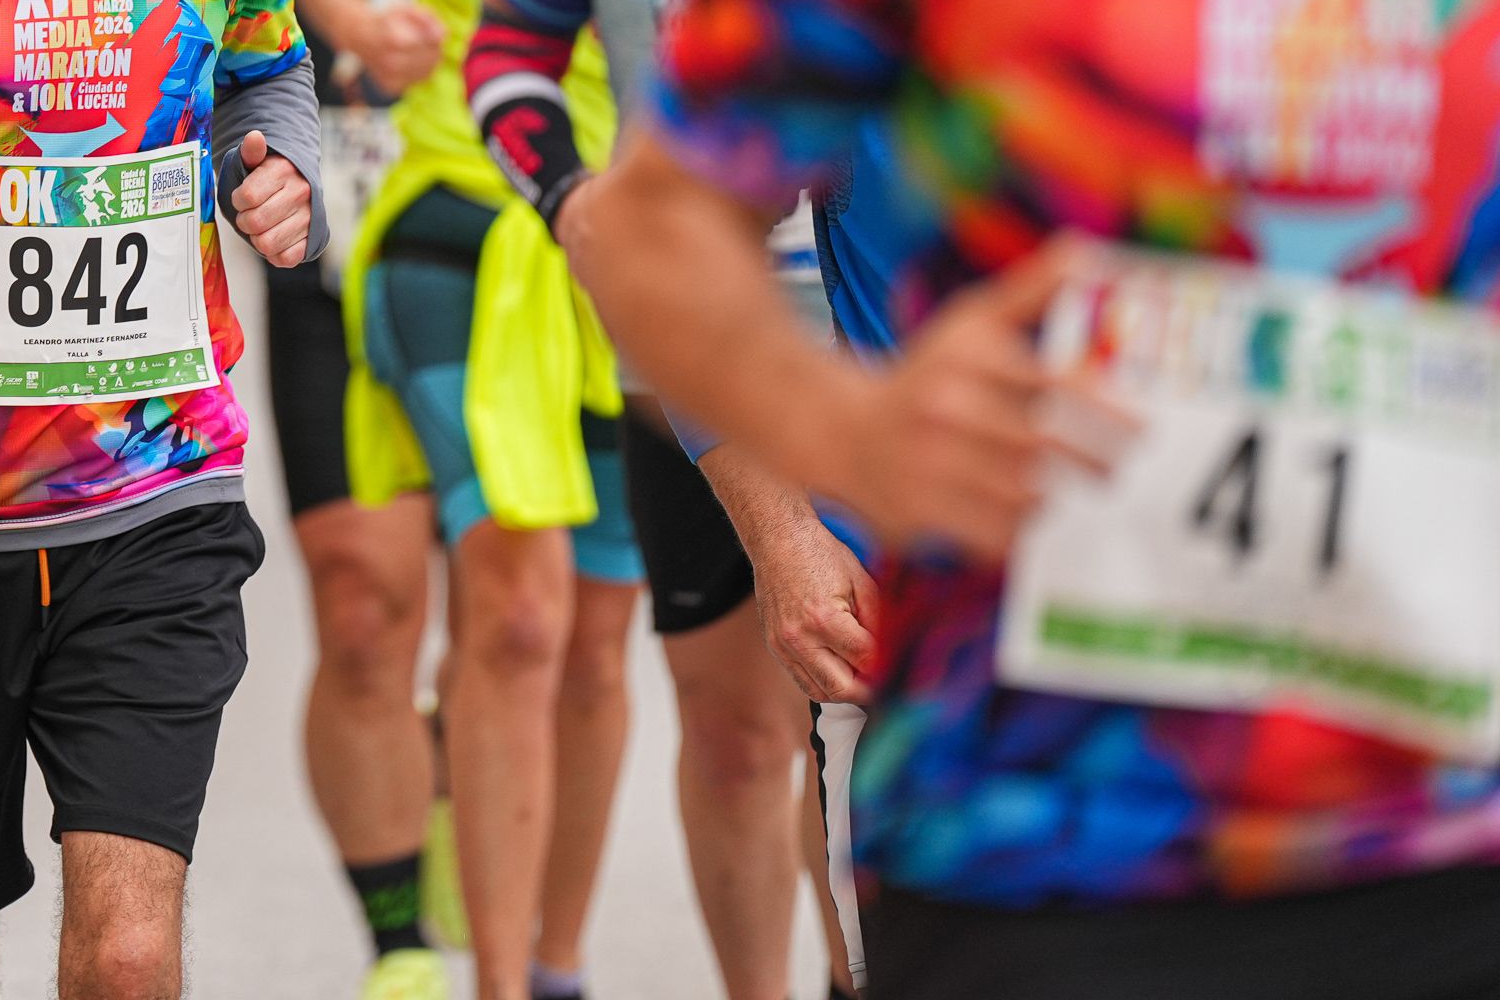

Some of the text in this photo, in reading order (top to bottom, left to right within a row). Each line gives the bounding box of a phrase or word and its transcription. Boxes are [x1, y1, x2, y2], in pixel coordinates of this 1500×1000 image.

[93, 0, 134, 13] MARZO
[13, 19, 92, 51] MEDIA
[94, 16, 134, 35] 2026
[13, 42, 132, 82] MARATÓN
[78, 80, 128, 94] Ciudad de
[12, 82, 74, 113] & 10K
[77, 93, 126, 110] LUCENA
[152, 167, 184, 182] carreras
[152, 175, 190, 194] populares
[120, 199, 146, 219] 2026
[8, 232, 148, 327] 842
[106, 332, 148, 342] FERNANDEZ
[1187, 430, 1350, 577] 41
